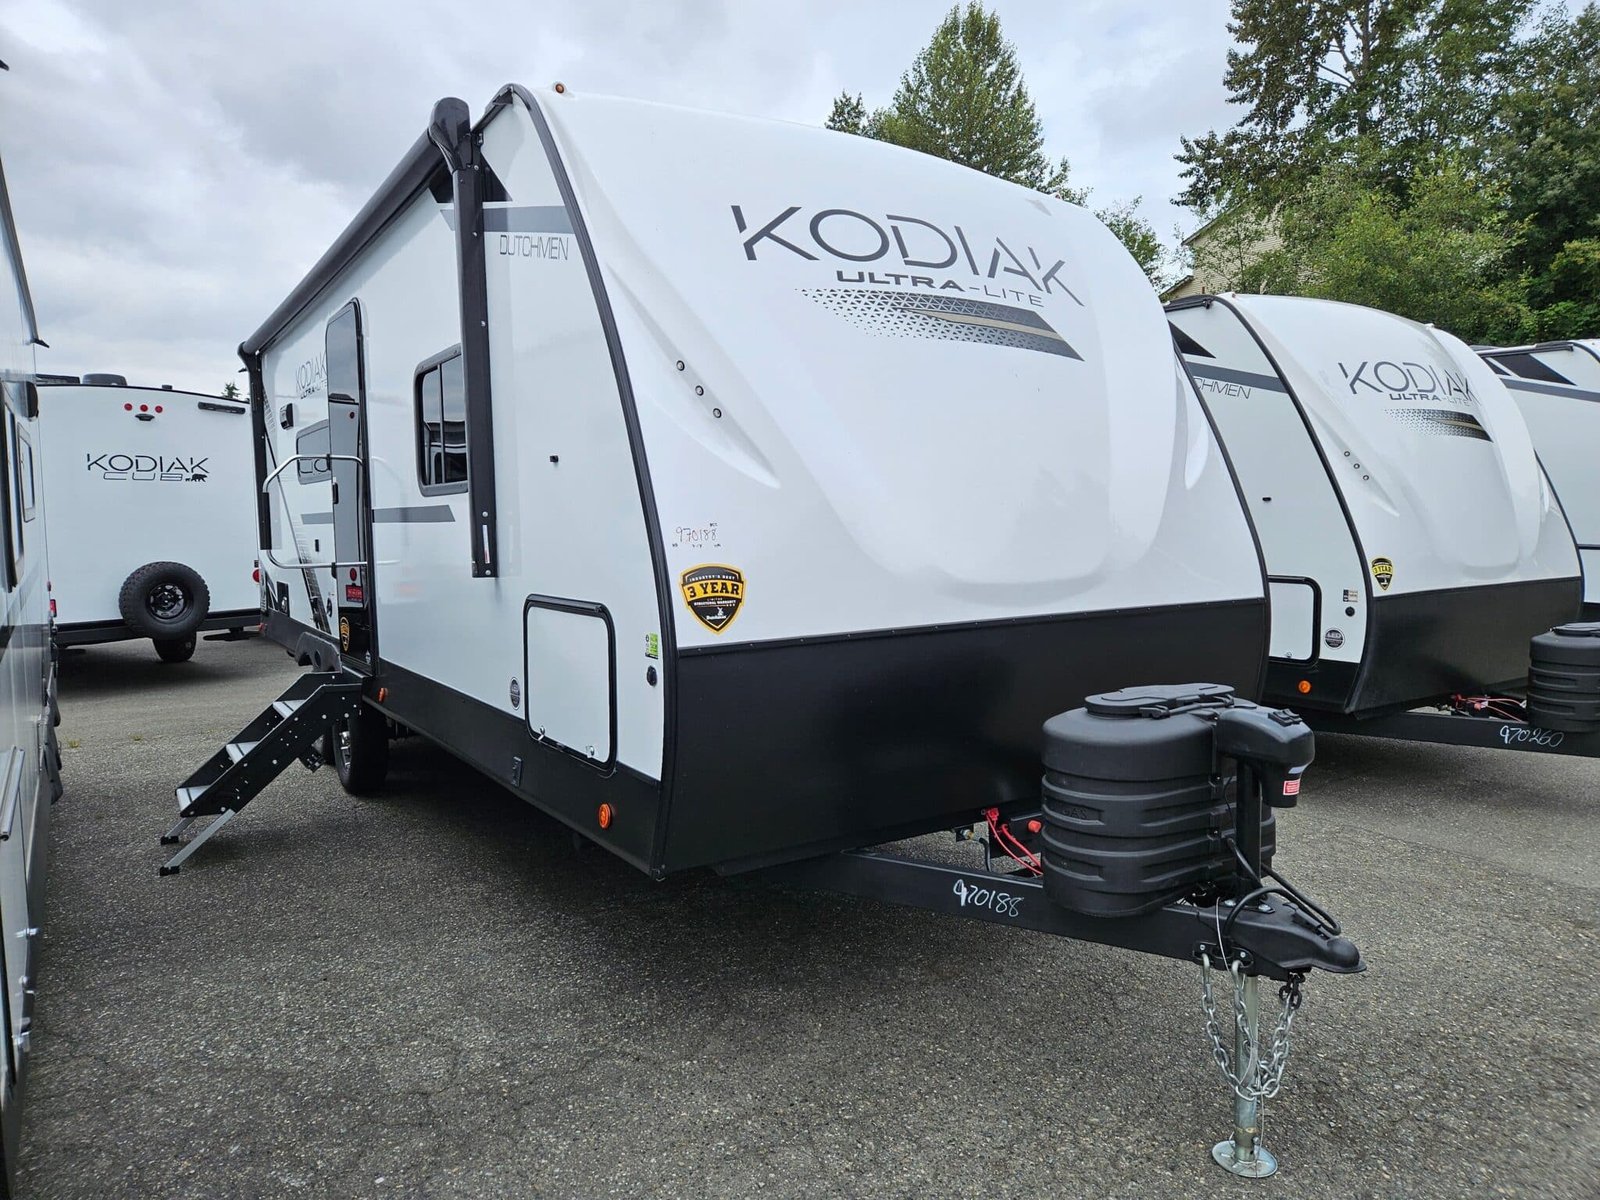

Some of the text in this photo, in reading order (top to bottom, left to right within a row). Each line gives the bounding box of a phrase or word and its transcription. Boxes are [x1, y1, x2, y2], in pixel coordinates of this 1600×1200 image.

[500, 234, 569, 261] DUTCHMEN
[732, 204, 1084, 307] KODIAK
[836, 270, 1045, 308] ULTRA-LITE
[1338, 361, 1482, 405] KODIAK
[87, 453, 209, 473] KODIAK
[103, 472, 183, 481] CUB
[675, 526, 718, 543] 970188
[687, 581, 739, 598] 3 YEAR
[1499, 725, 1565, 748] 970260
[953, 878, 1025, 918] 970188
